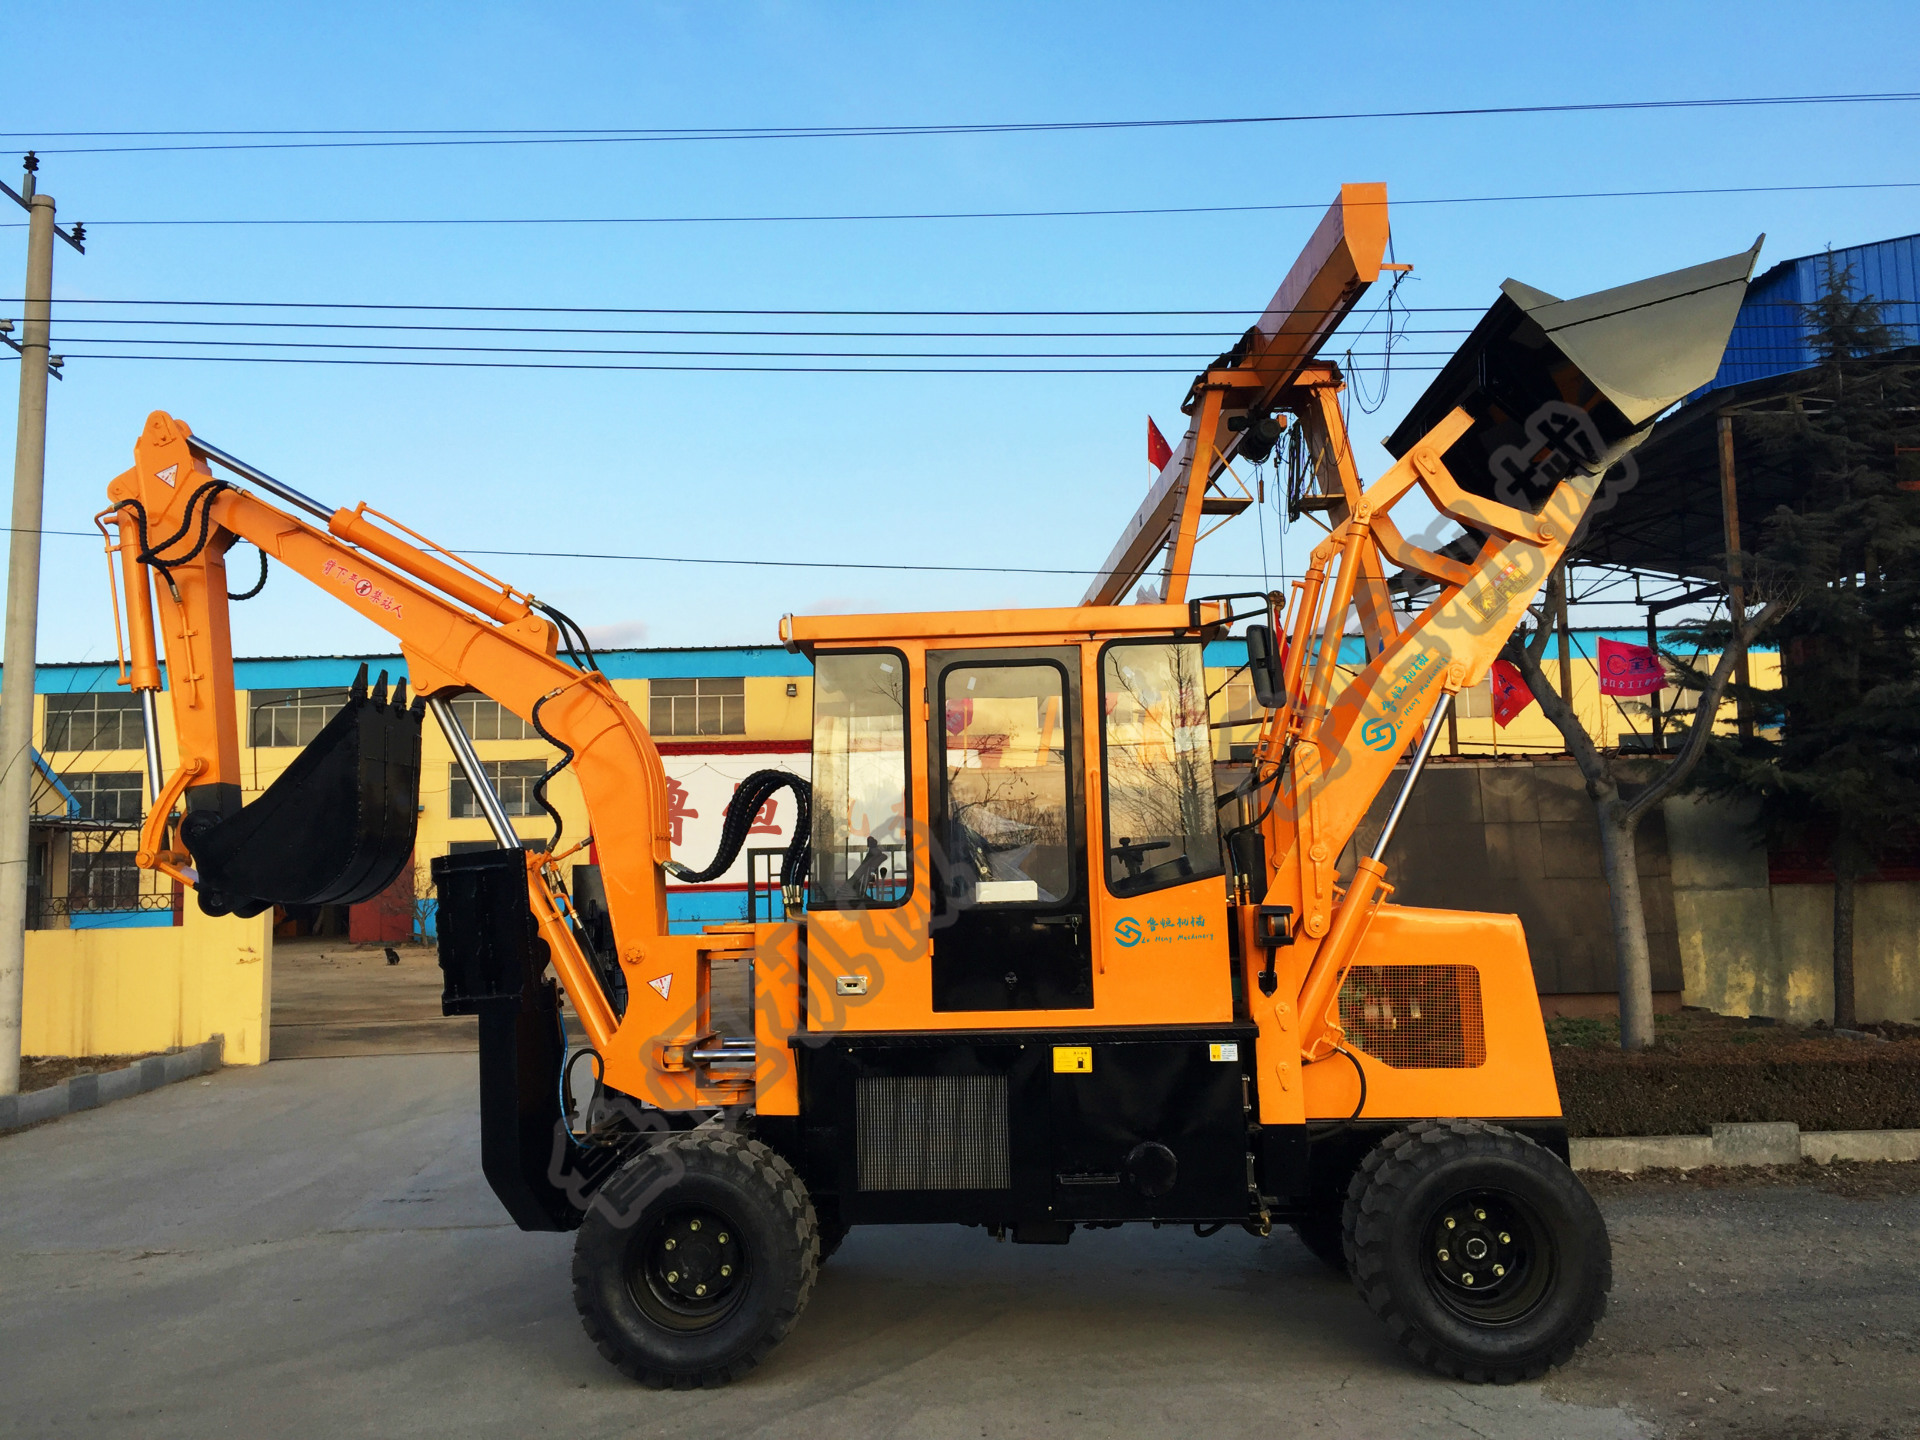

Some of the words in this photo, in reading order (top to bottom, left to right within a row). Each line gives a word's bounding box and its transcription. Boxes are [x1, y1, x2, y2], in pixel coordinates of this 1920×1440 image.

[1381, 653, 1430, 713] 鲁恒机械
[1146, 914, 1206, 932] 鲁恒机械
